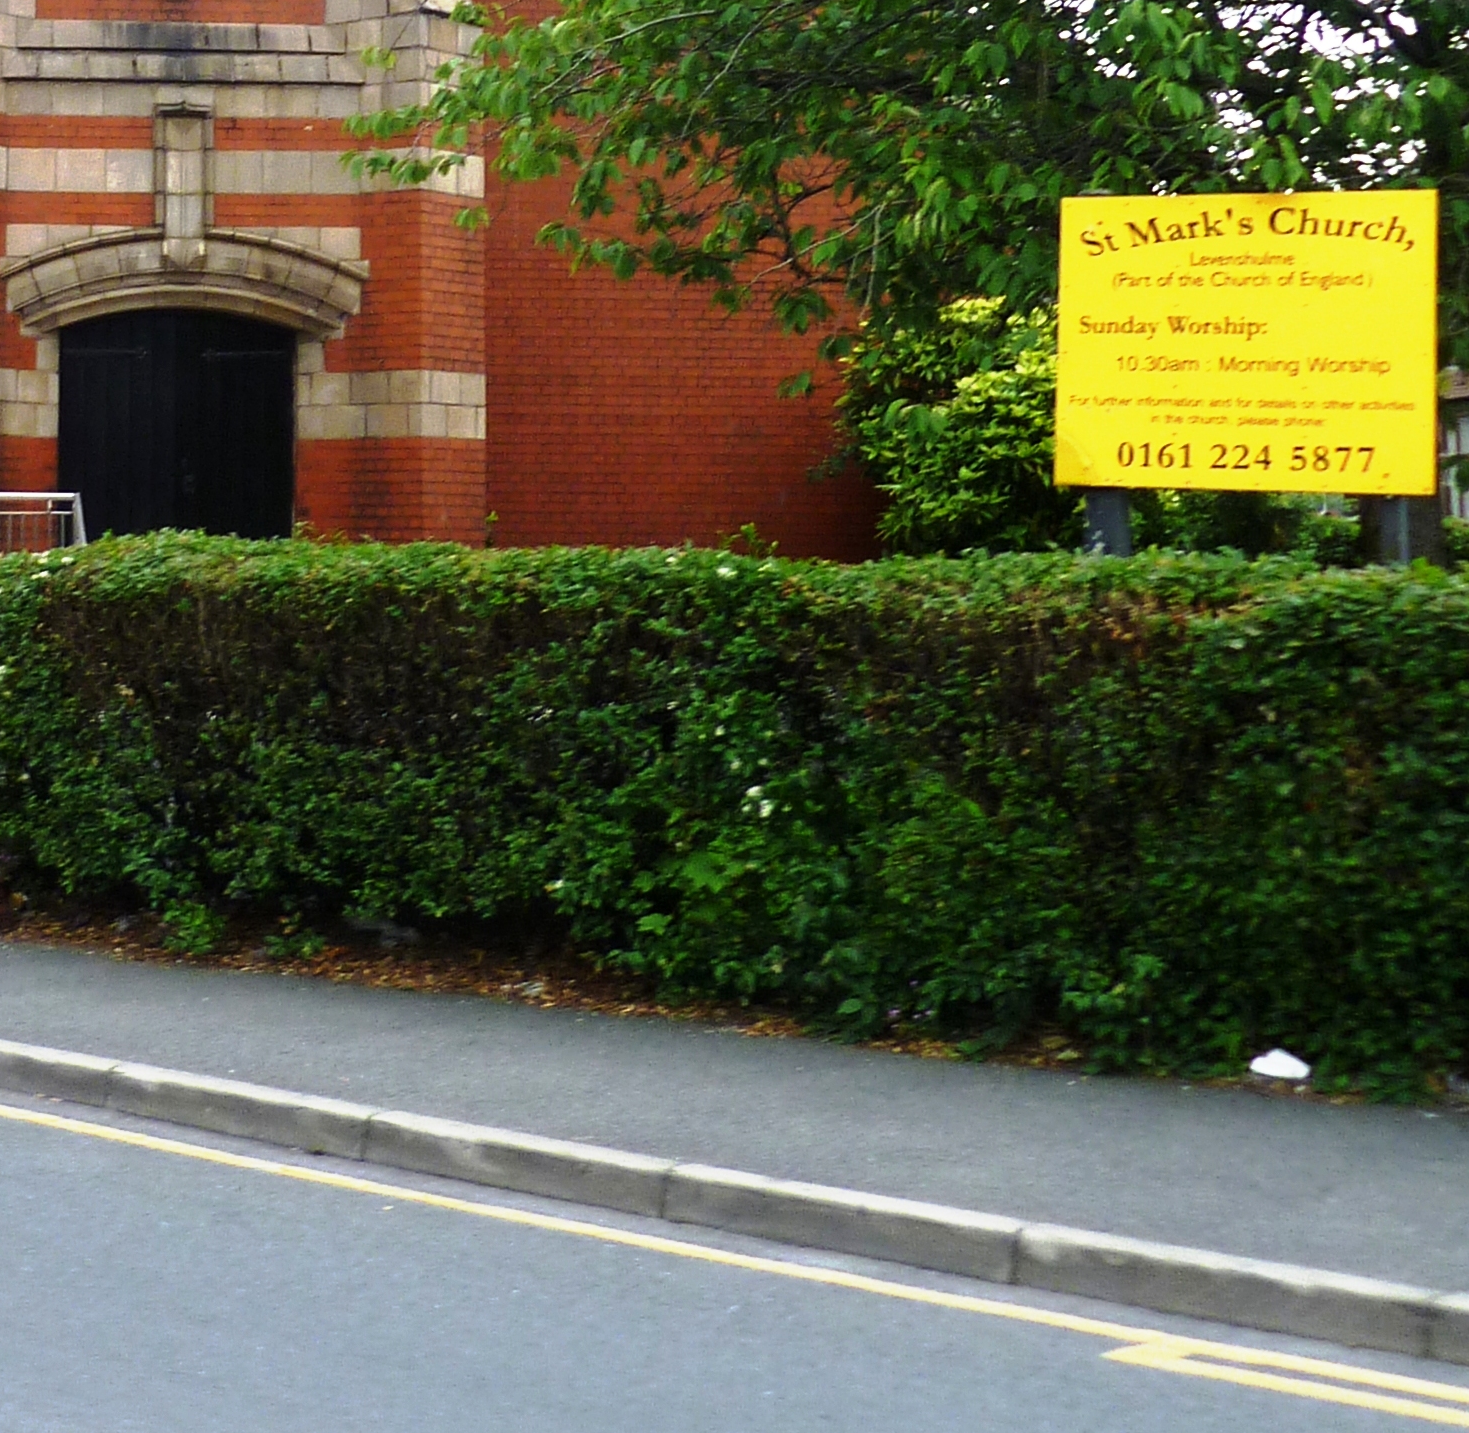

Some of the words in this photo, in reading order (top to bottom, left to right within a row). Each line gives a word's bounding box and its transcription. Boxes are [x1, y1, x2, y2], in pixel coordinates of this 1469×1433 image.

[1079, 229, 1120, 257] St
[1124, 207, 1254, 248] Mark's
[1267, 206, 1416, 252] Church,
[1189, 251, 1296, 267] Levenshulme
[1112, 271, 1151, 291] (Part
[1157, 271, 1175, 288] of
[1179, 272, 1204, 288] the
[1210, 271, 1271, 288] Church
[1278, 270, 1296, 288] of
[1079, 315, 1161, 341] Sunday
[1167, 315, 1268, 342] Worship:
[1116, 355, 1201, 373] 10.30am
[1218, 355, 1300, 377] Morning
[1307, 356, 1392, 378] Worship
[1136, 396, 1203, 408] information
[1117, 441, 1194, 469] 0161
[1208, 444, 1273, 471] 224
[1289, 445, 1376, 473] 5877
